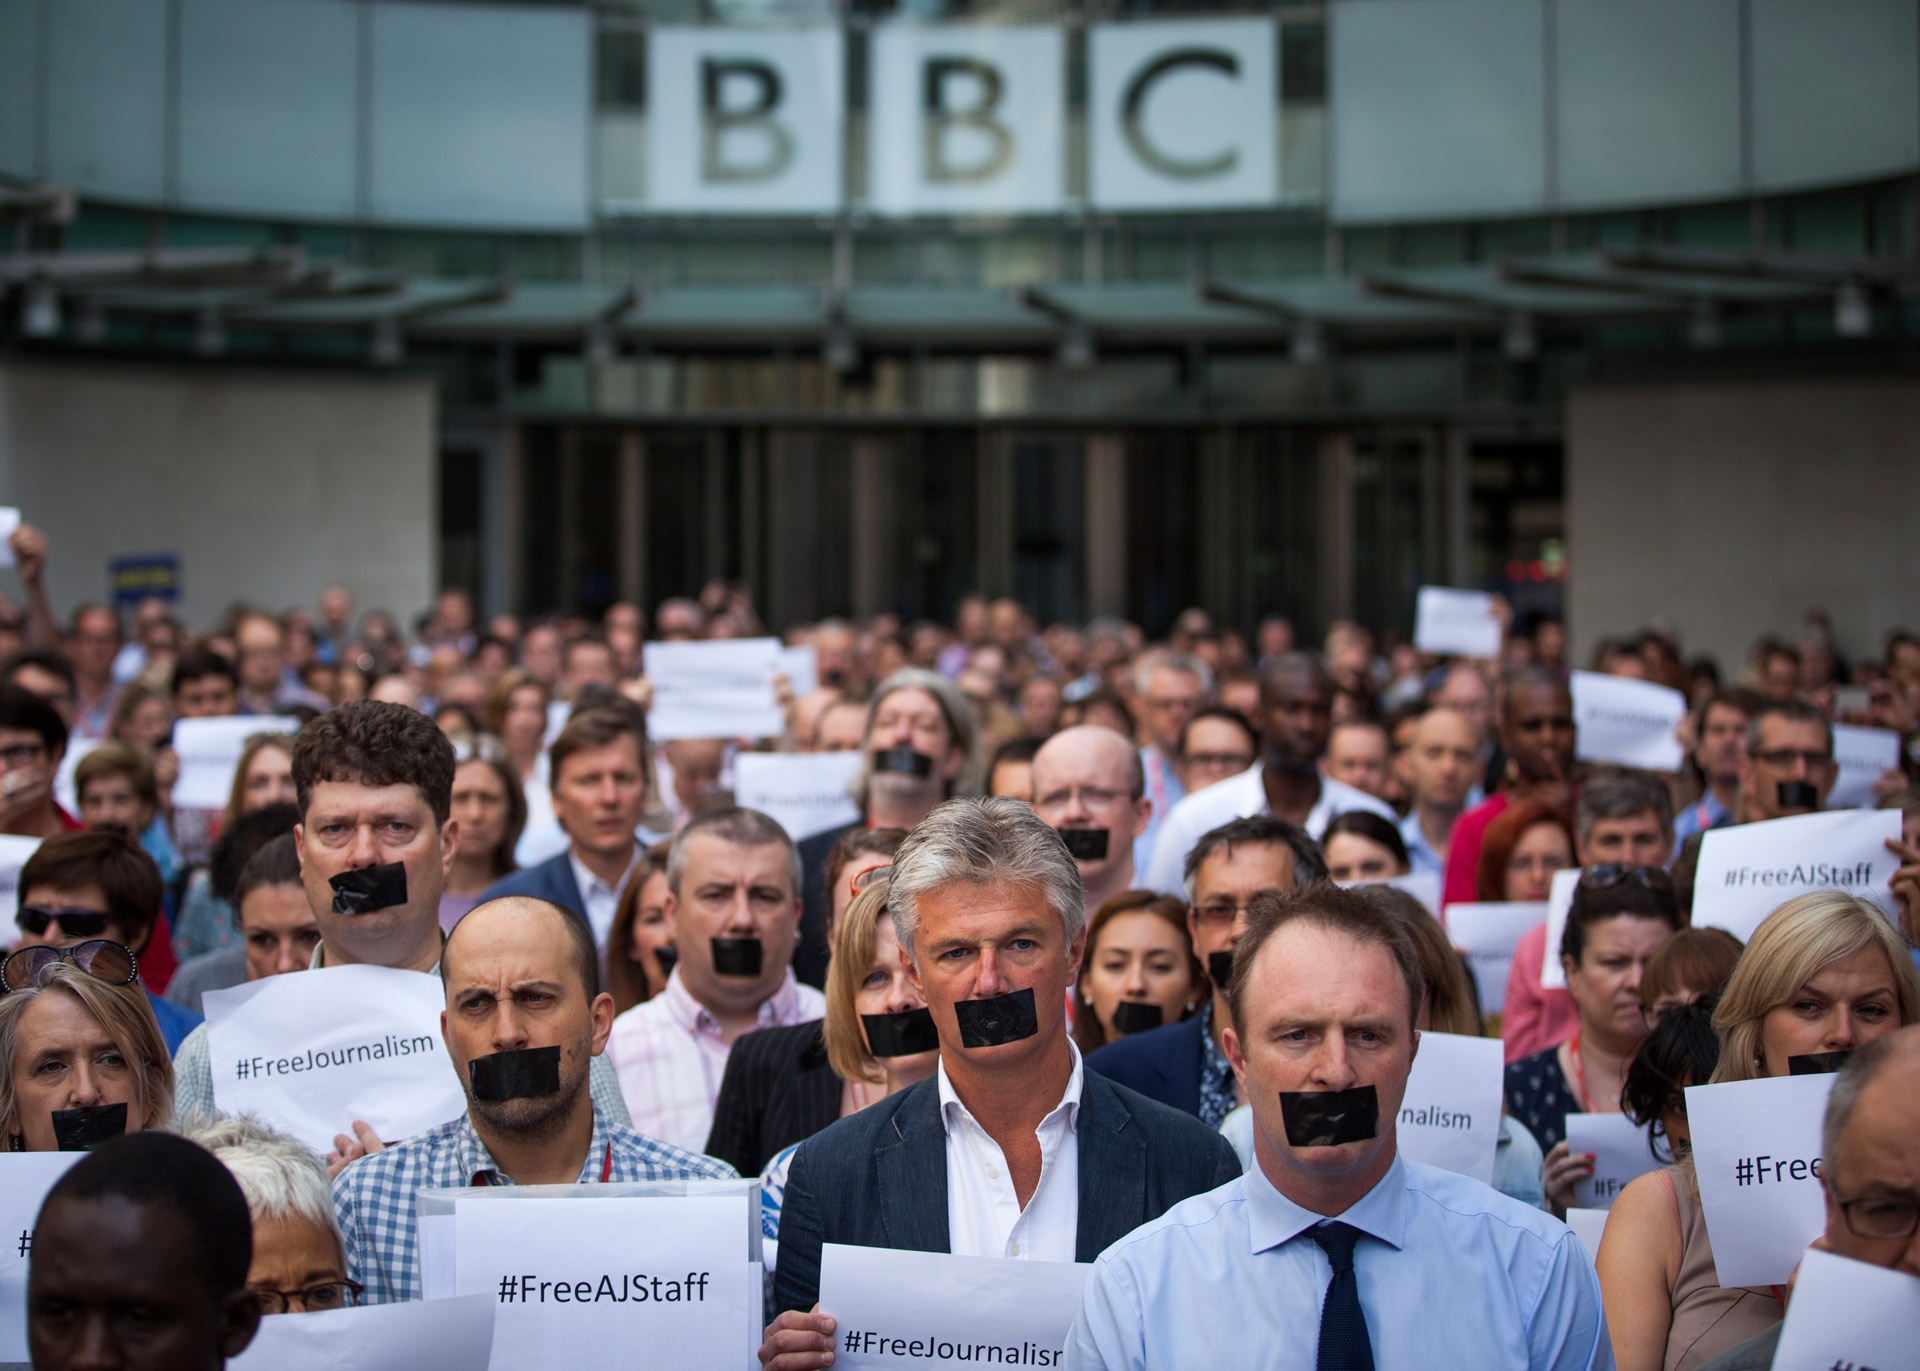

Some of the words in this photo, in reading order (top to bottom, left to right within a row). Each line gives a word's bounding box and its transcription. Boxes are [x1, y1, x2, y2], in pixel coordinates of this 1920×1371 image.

[701, 46, 1242, 183] BBC
[1724, 862, 1873, 887] #FreeAJStaff
[236, 1035, 434, 1080] #FreeJournalism
[498, 1272, 710, 1303] #FreeAJStaff
